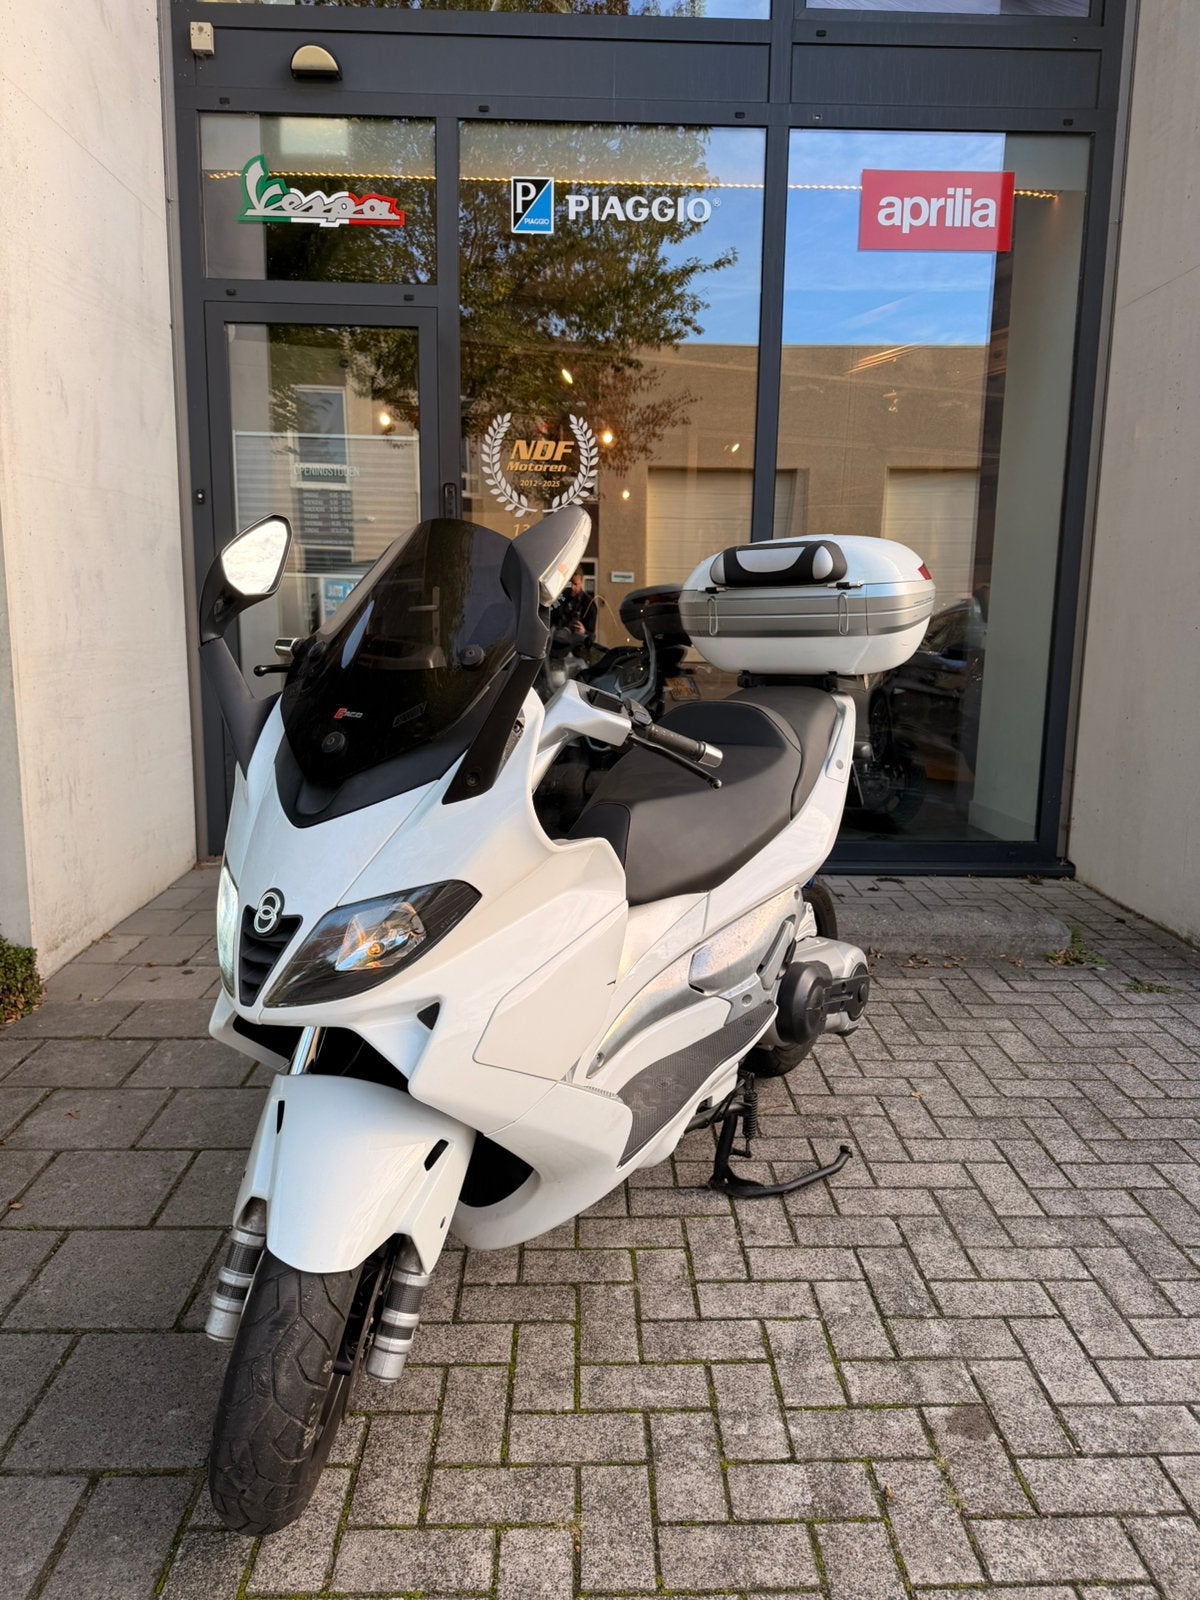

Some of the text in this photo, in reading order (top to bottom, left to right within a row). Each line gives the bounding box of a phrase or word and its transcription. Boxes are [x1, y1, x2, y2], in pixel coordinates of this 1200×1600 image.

[243, 159, 402, 223] Vespa
[515, 182, 537, 214] P
[524, 217, 550, 225] PIAGGIO
[565, 194, 712, 223] PIAGGIO
[877, 187, 997, 234] aprilia
[510, 439, 575, 461] NDF
[506, 460, 567, 473] Motoren
